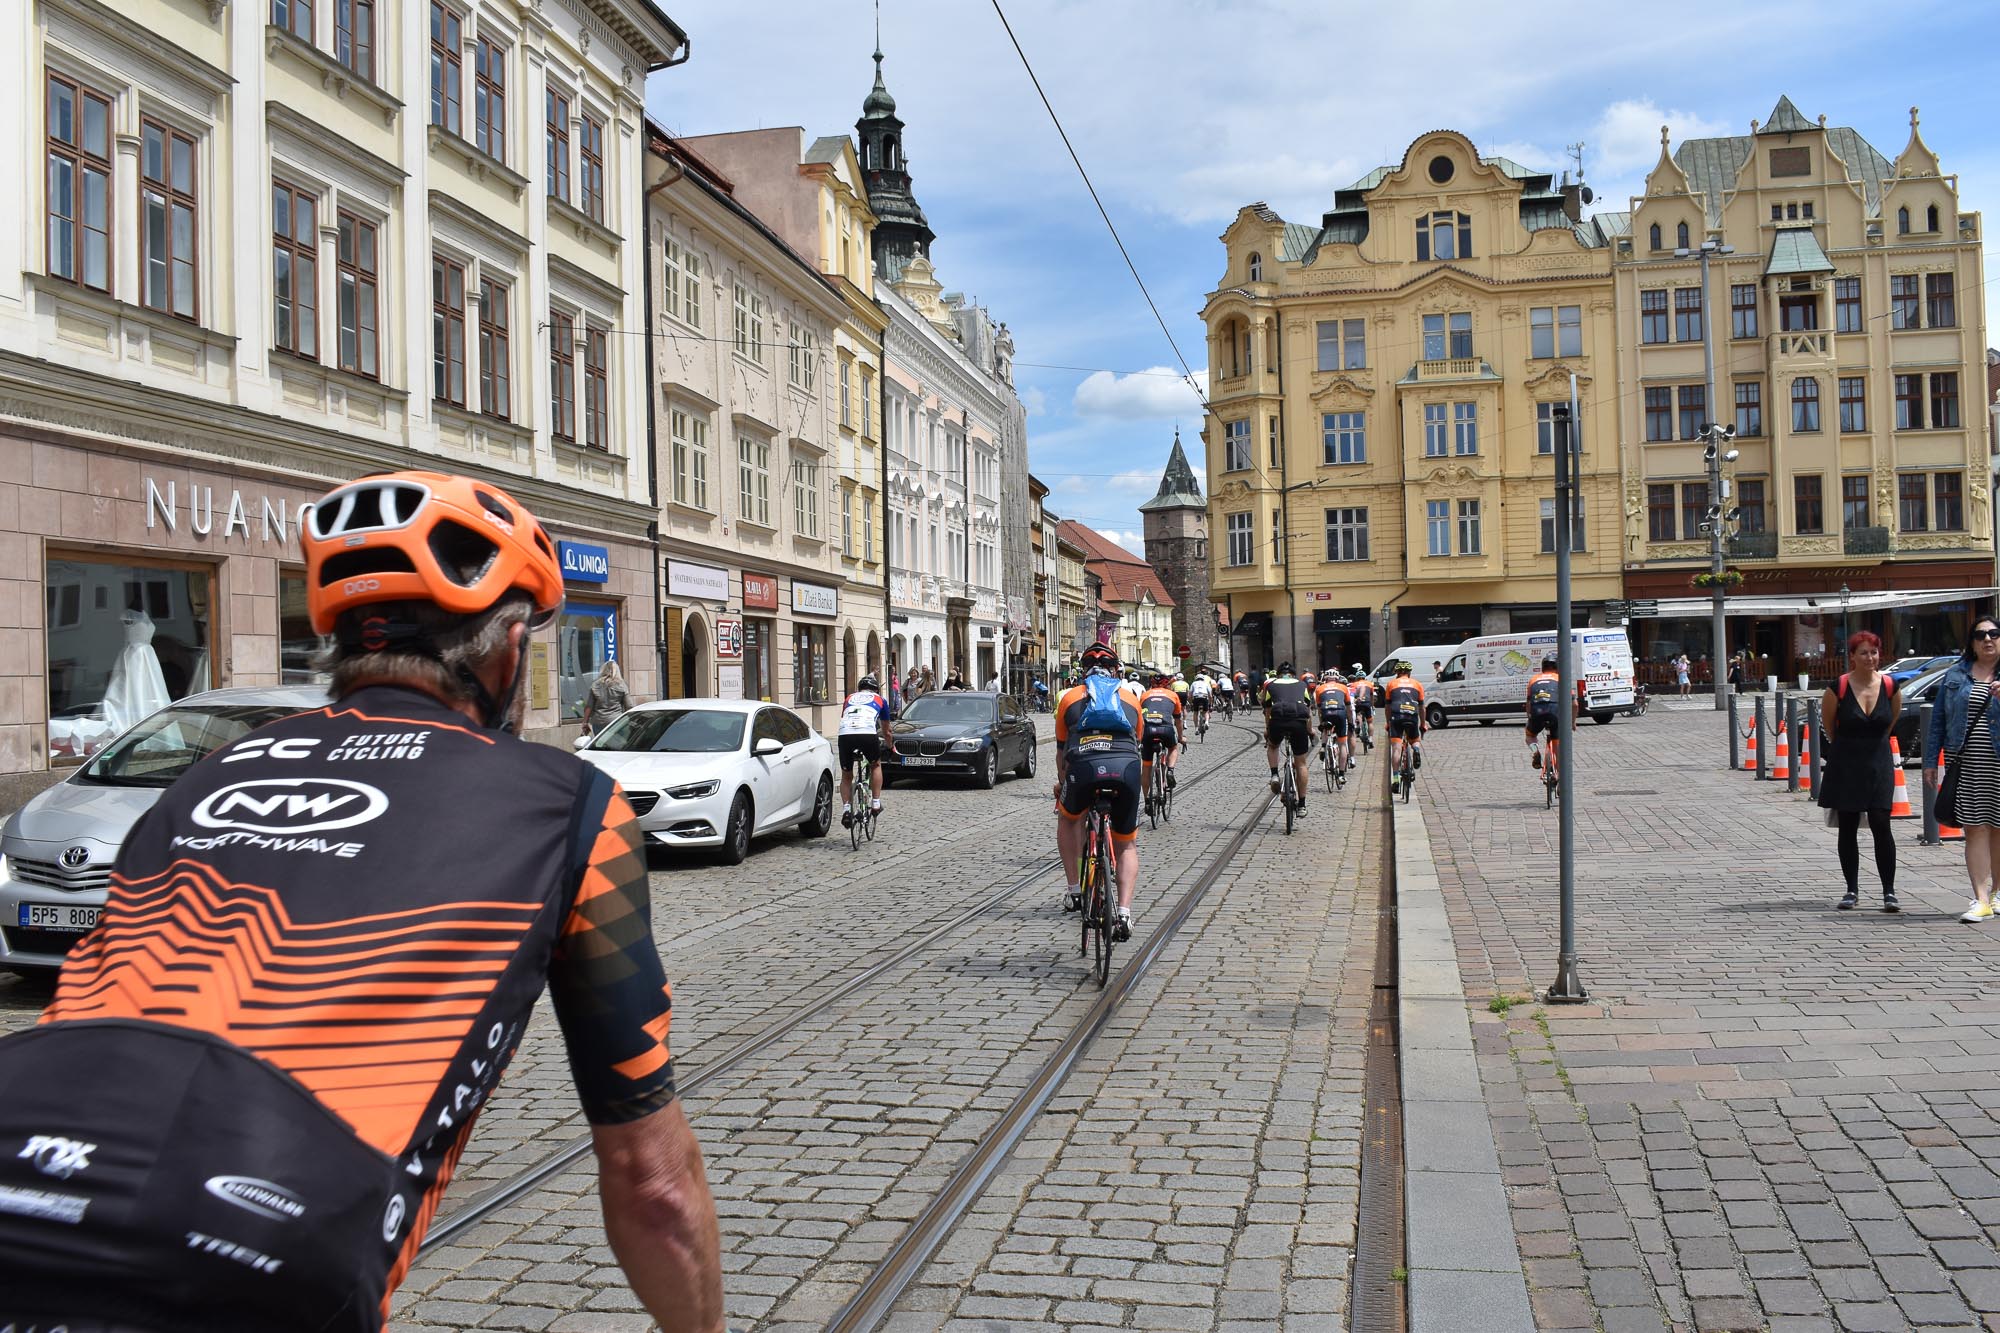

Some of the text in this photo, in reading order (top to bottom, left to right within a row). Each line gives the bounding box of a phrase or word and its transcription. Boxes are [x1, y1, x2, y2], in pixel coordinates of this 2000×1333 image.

[578, 554, 608, 575] UNIQA
[745, 580, 762, 595] SLAVIA
[817, 592, 833, 610] Banka
[341, 731, 432, 747] FUTURE
[326, 745, 425, 761] CYCLING
[213, 791, 361, 817] NW
[169, 831, 365, 858] NORTHWAVE
[32, 907, 58, 924] 5P5
[17, 1135, 98, 1180] FOX
[184, 1231, 284, 1274] TREK
